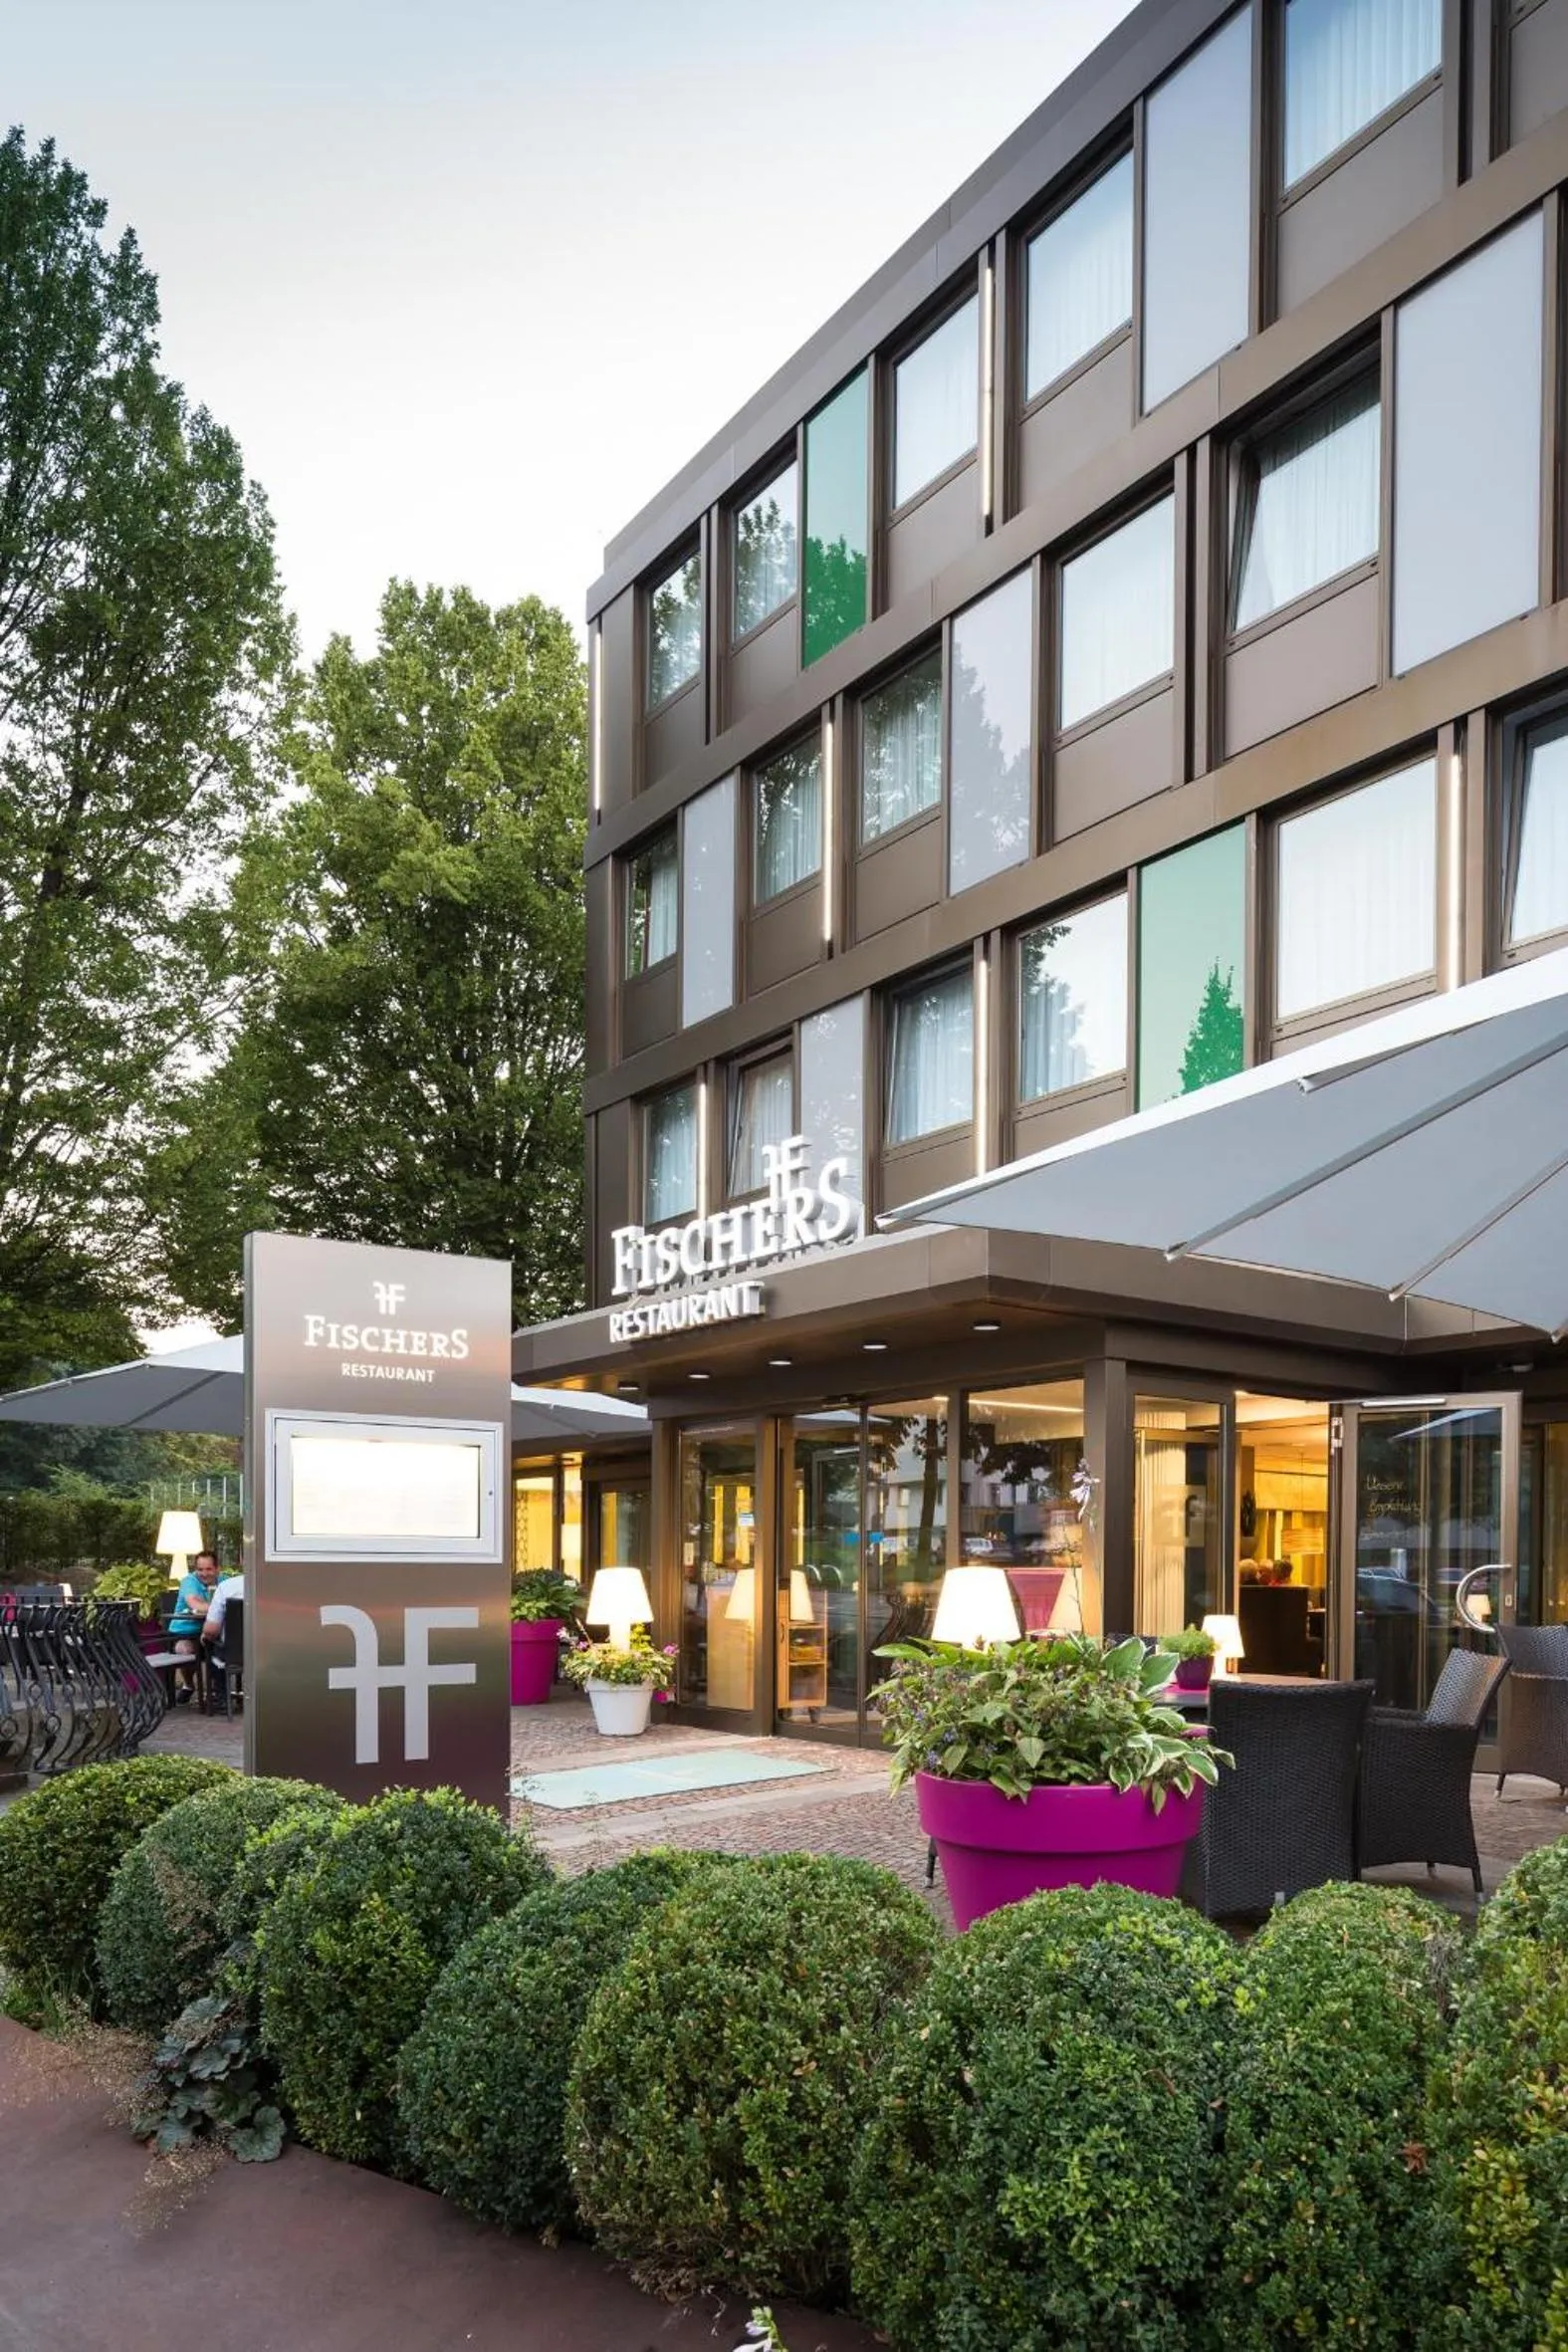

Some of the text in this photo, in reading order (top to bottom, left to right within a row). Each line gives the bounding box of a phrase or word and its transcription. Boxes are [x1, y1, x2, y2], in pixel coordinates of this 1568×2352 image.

[611, 1157, 862, 1295] FISCHERS
[303, 1313, 470, 1360] FISCHERS
[610, 1281, 765, 1342] RESTAURANT
[340, 1361, 436, 1383] RESTAURANT
